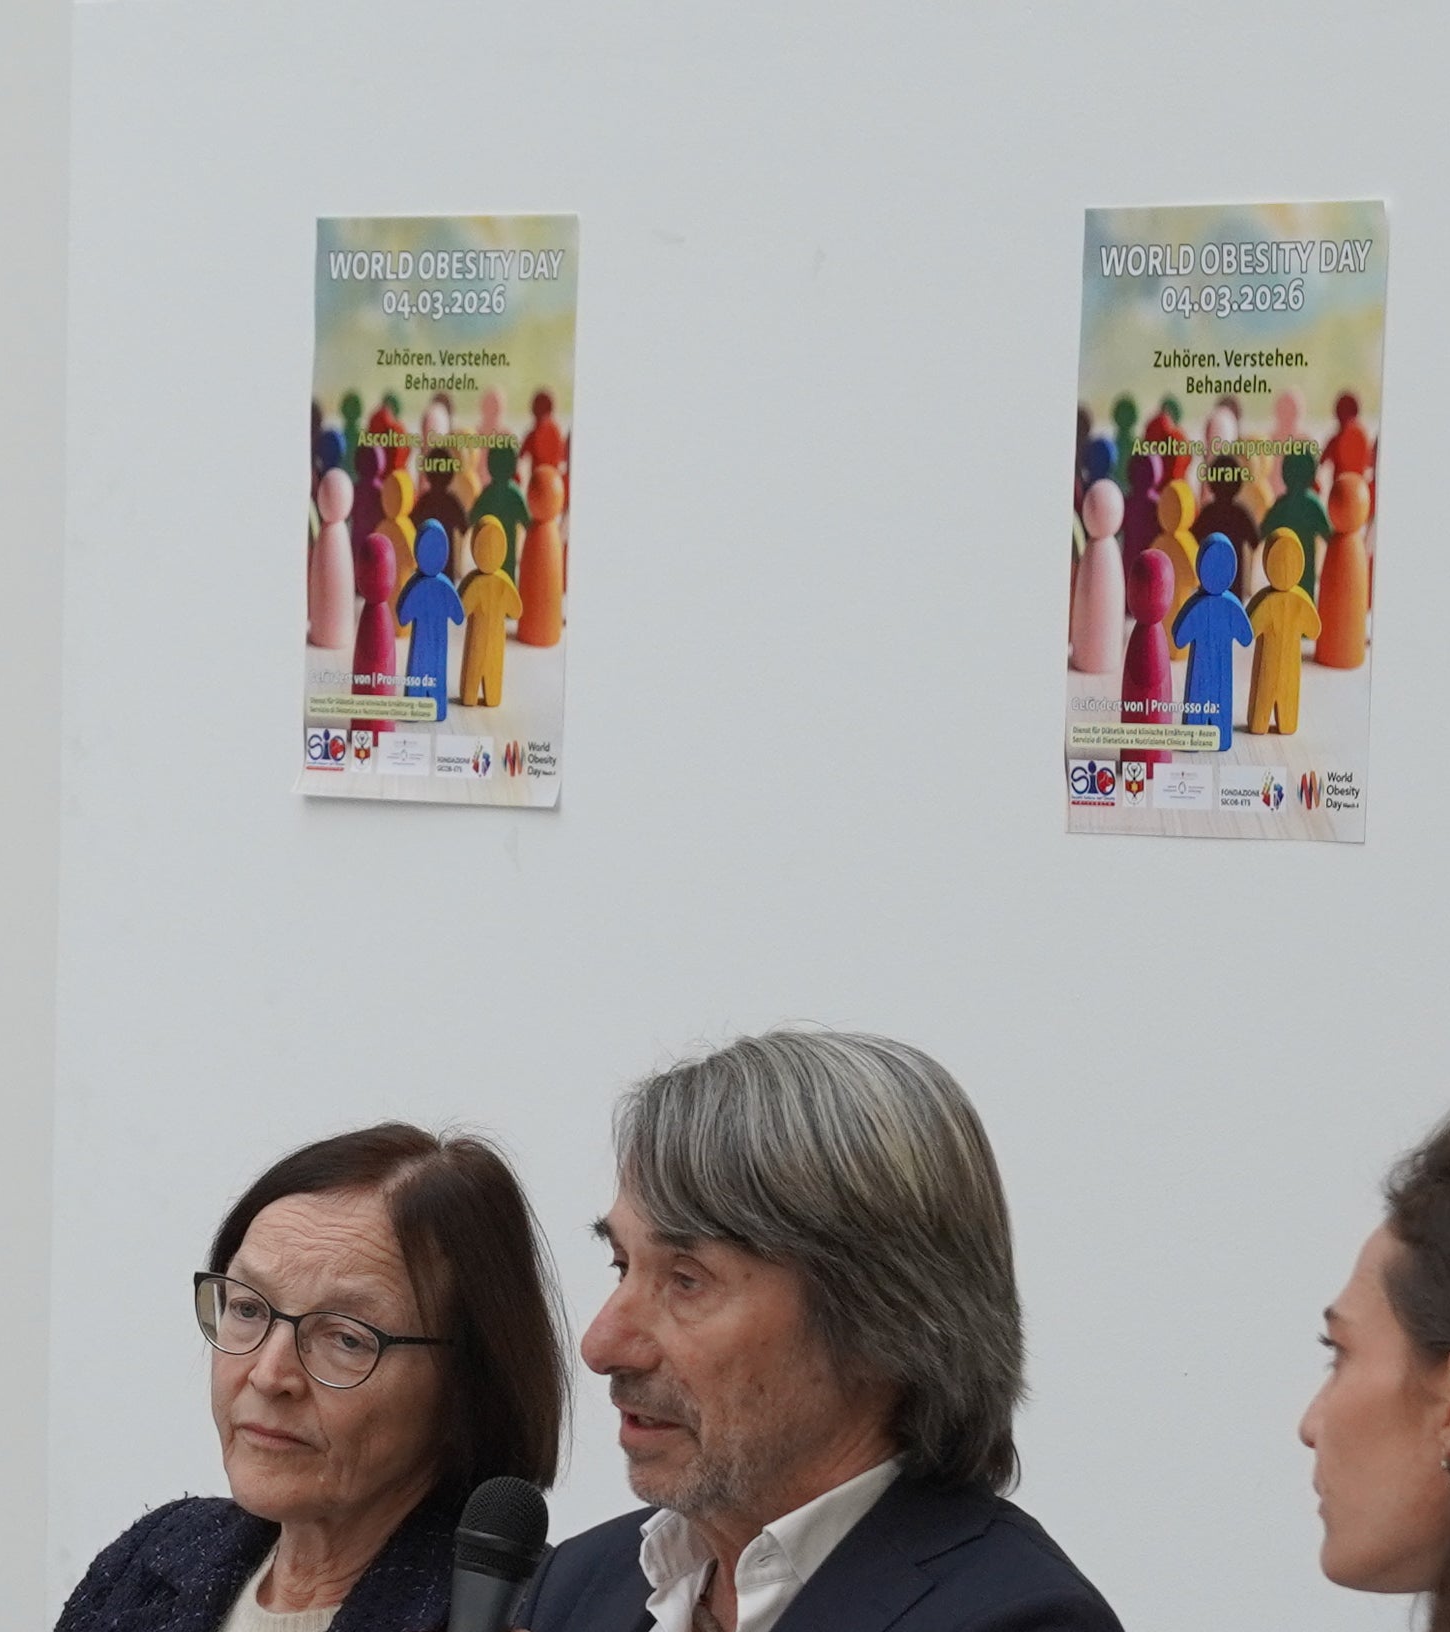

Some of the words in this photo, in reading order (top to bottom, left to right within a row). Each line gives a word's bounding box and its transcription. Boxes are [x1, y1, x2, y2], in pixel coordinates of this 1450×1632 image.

[329, 251, 413, 280] WORLD
[418, 250, 514, 280] OBESITY
[518, 249, 564, 280] DAY
[1100, 244, 1195, 277] WORLD
[1200, 240, 1315, 276] OBESITY
[1319, 239, 1372, 273] DAY
[382, 284, 506, 320] 04.03.2026
[1161, 278, 1304, 318] 04.03.2026
[376, 349, 436, 367] Zuhören.
[439, 349, 510, 367] Verstehen.
[1153, 349, 1220, 368] Zuhören.
[1224, 348, 1308, 367] Verstehen.
[405, 374, 479, 391] Behandeln.
[1186, 375, 1272, 394] Behandeln.
[1131, 438, 1207, 456] Ascoltare.
[1197, 464, 1253, 482] Curare.
[355, 674, 371, 685] von
[1124, 701, 1143, 712] von
[1151, 700, 1201, 713] Promosso
[1203, 700, 1220, 714] da:
[528, 741, 550, 752] World
[528, 754, 557, 766] Obesity
[527, 766, 541, 778] Day
[1327, 772, 1353, 782] World
[1326, 784, 1360, 799] Obesity
[1326, 797, 1343, 811] Day
